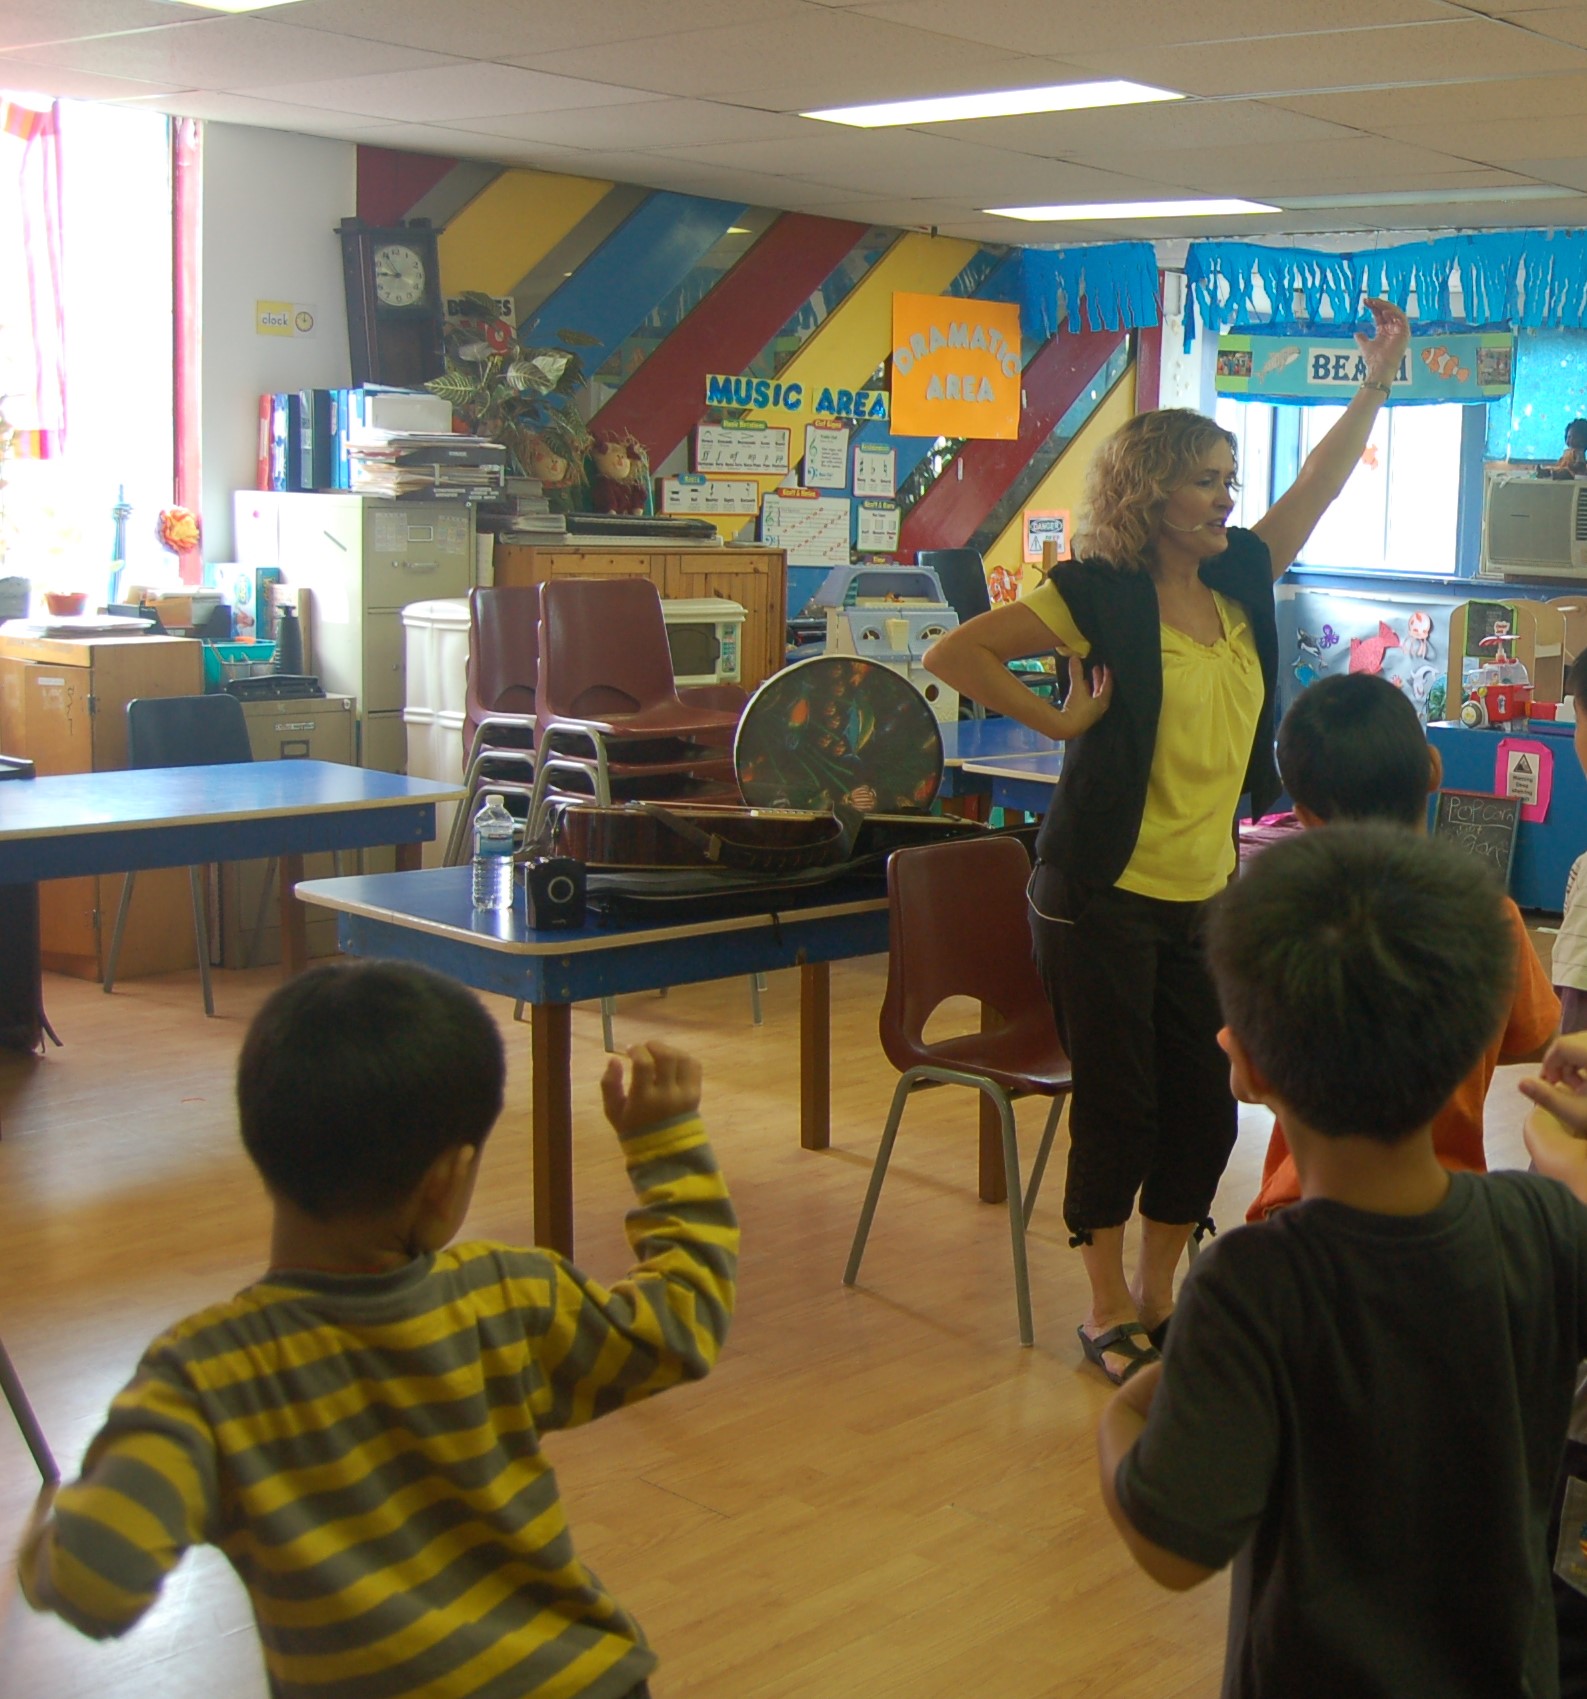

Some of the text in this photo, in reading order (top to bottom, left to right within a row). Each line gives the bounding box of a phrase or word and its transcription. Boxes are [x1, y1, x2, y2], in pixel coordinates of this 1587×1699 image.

[262, 312, 288, 325] clock
[893, 321, 1022, 378] DRAMATIC
[707, 376, 887, 419] MUSIC AREA
[927, 373, 995, 402] AREA
